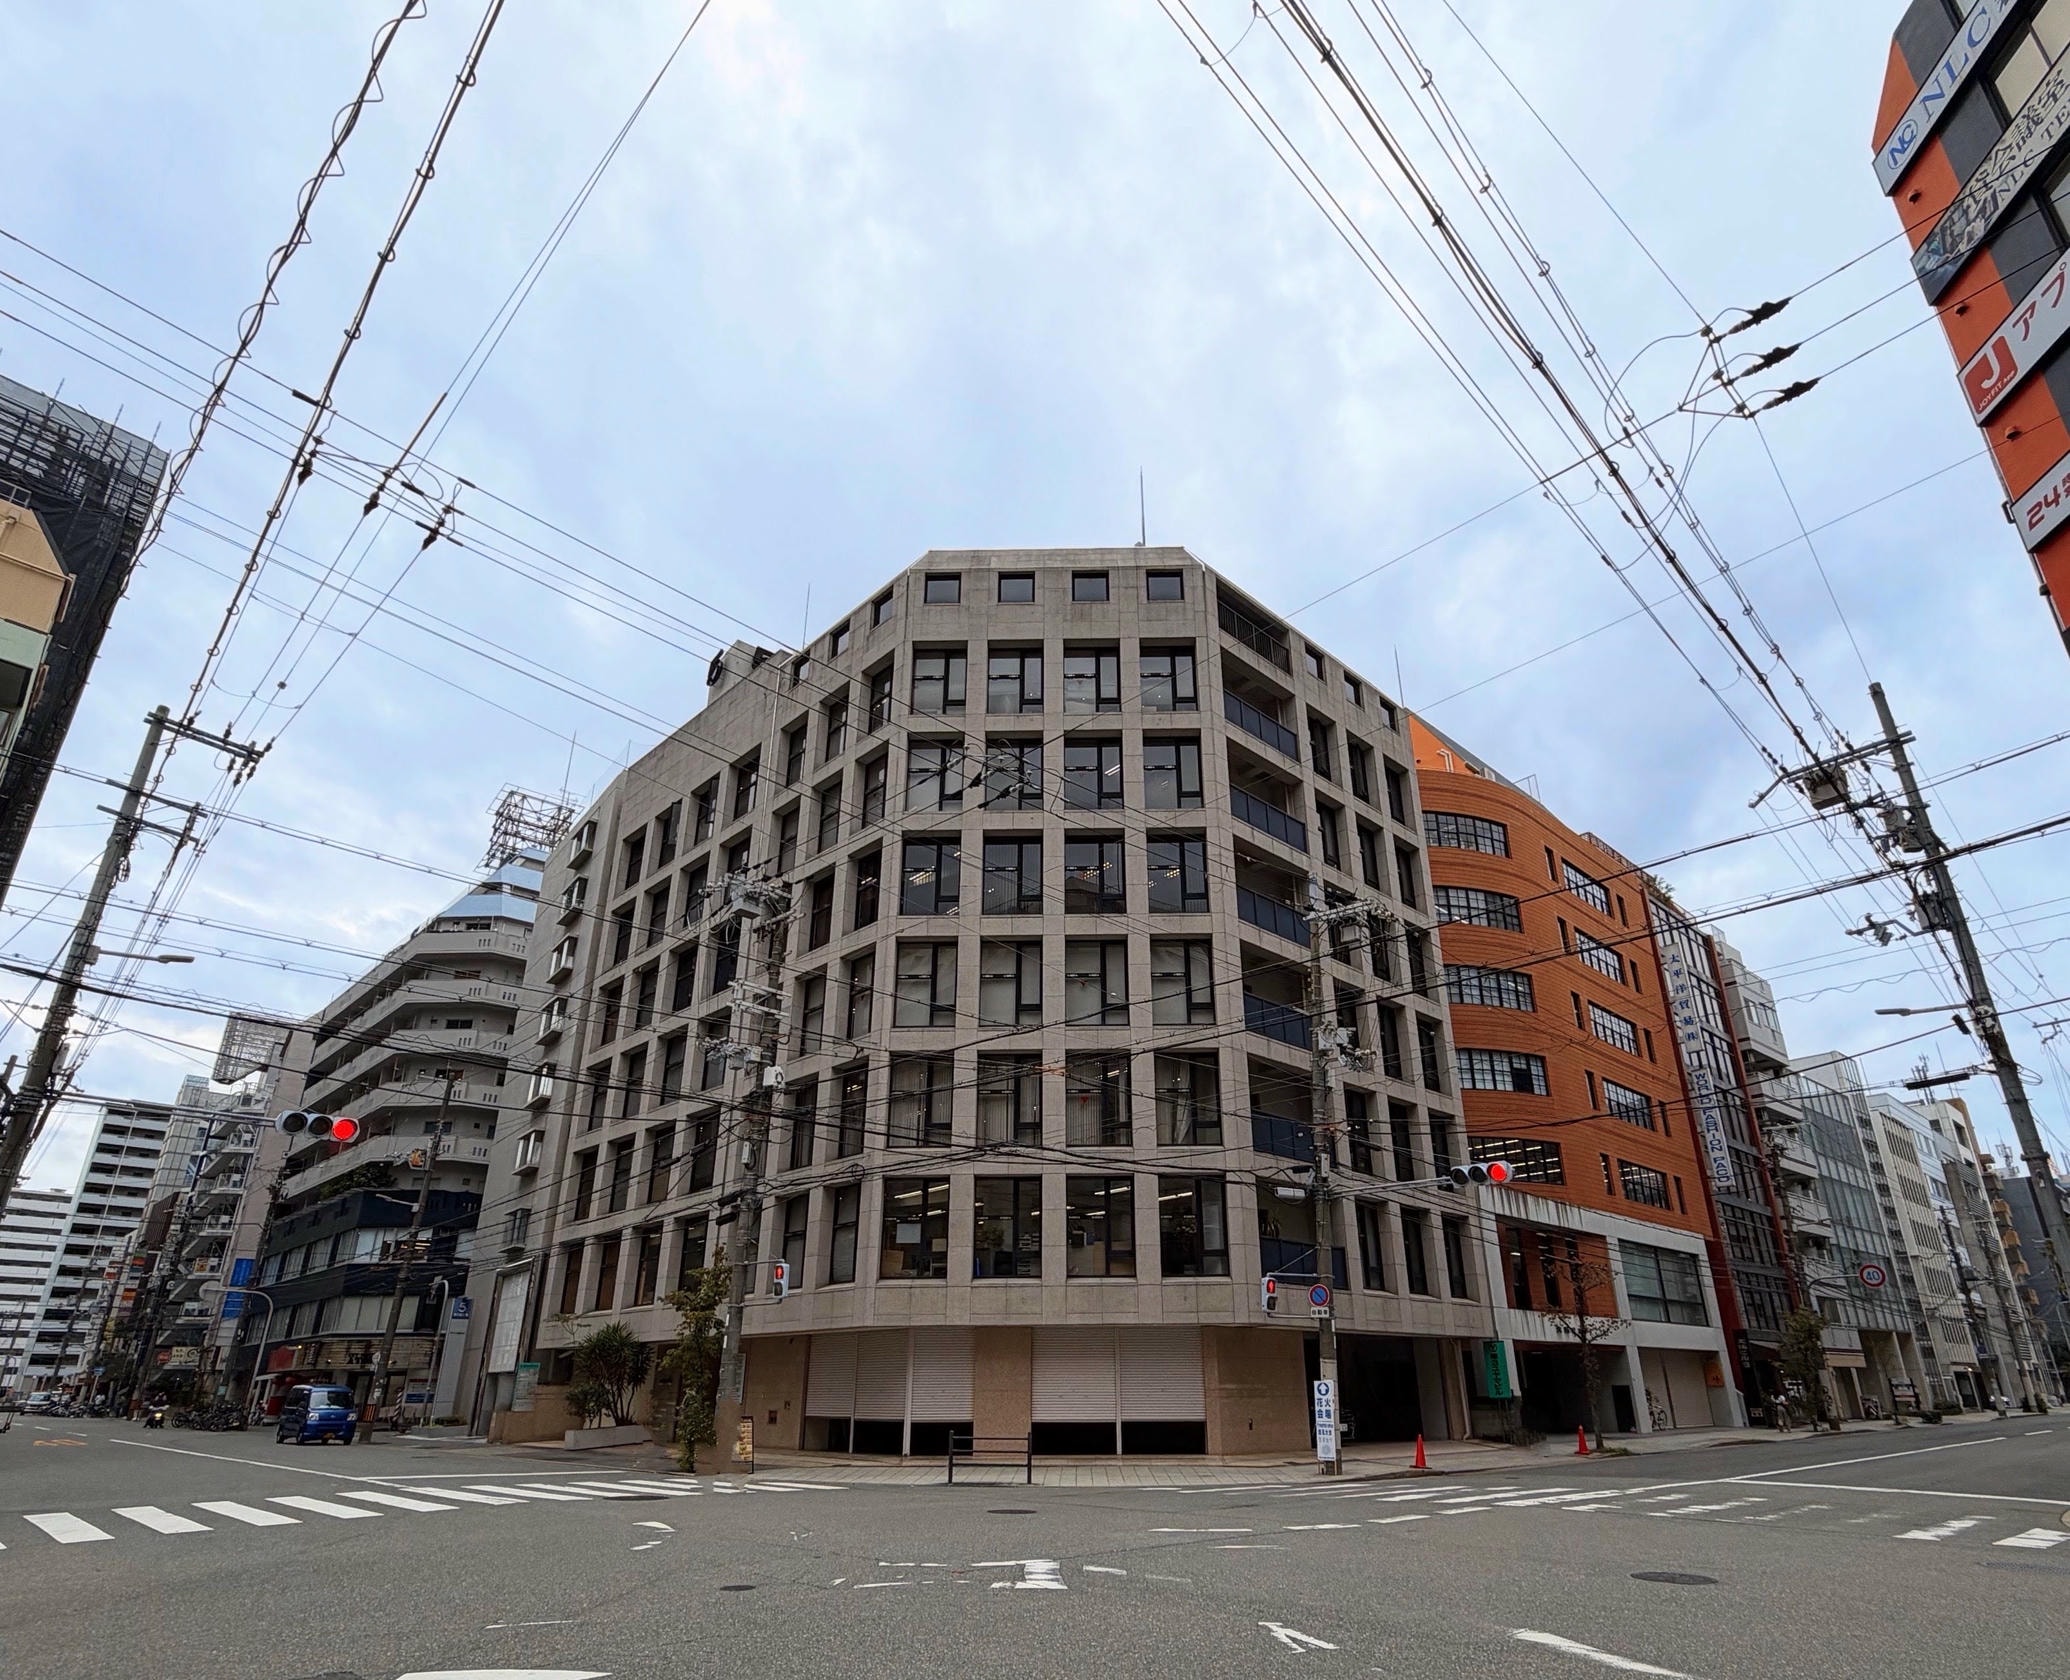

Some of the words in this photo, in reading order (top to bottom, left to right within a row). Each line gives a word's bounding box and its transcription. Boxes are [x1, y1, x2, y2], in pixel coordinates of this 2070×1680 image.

[1920, 8, 1992, 121] NLC
[1997, 148, 2036, 202] NLC
[2012, 262, 2067, 342] アプ
[1978, 381, 2003, 411] JOYFIT
[1694, 1072, 1712, 1105] WORLD
[1702, 1107, 1723, 1153] FASHION
[1713, 1156, 1731, 1183] PACO
[1866, 1270, 1881, 1281] 40
[458, 1302, 467, 1313] 5
